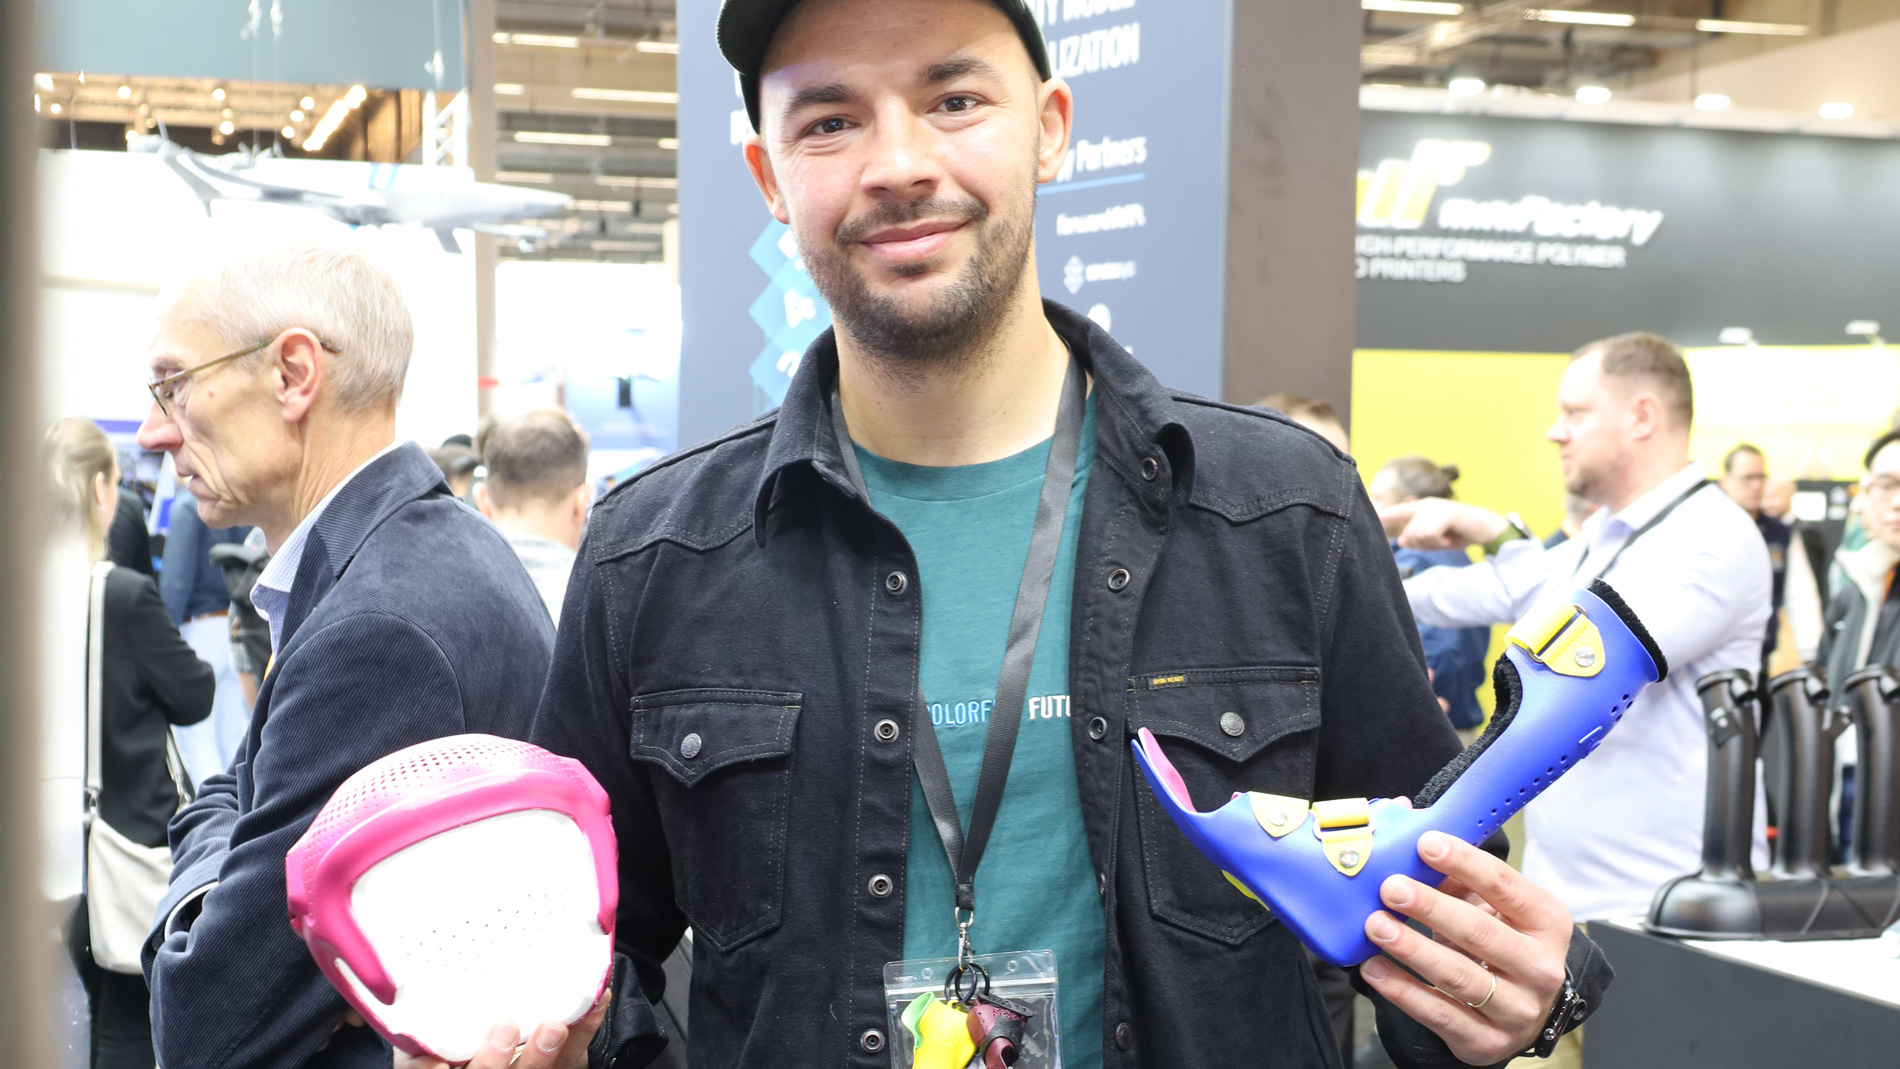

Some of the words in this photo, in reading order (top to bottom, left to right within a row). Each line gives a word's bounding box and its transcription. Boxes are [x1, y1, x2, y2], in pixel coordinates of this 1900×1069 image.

[1047, 22, 1140, 79] LIZATION
[1076, 135, 1147, 173] Partners
[1355, 234, 1536, 264] IGH-PERFORMANCE
[1536, 241, 1627, 269] POLYMER
[1369, 257, 1467, 283] PRINTERS
[926, 699, 996, 726] OLORF
